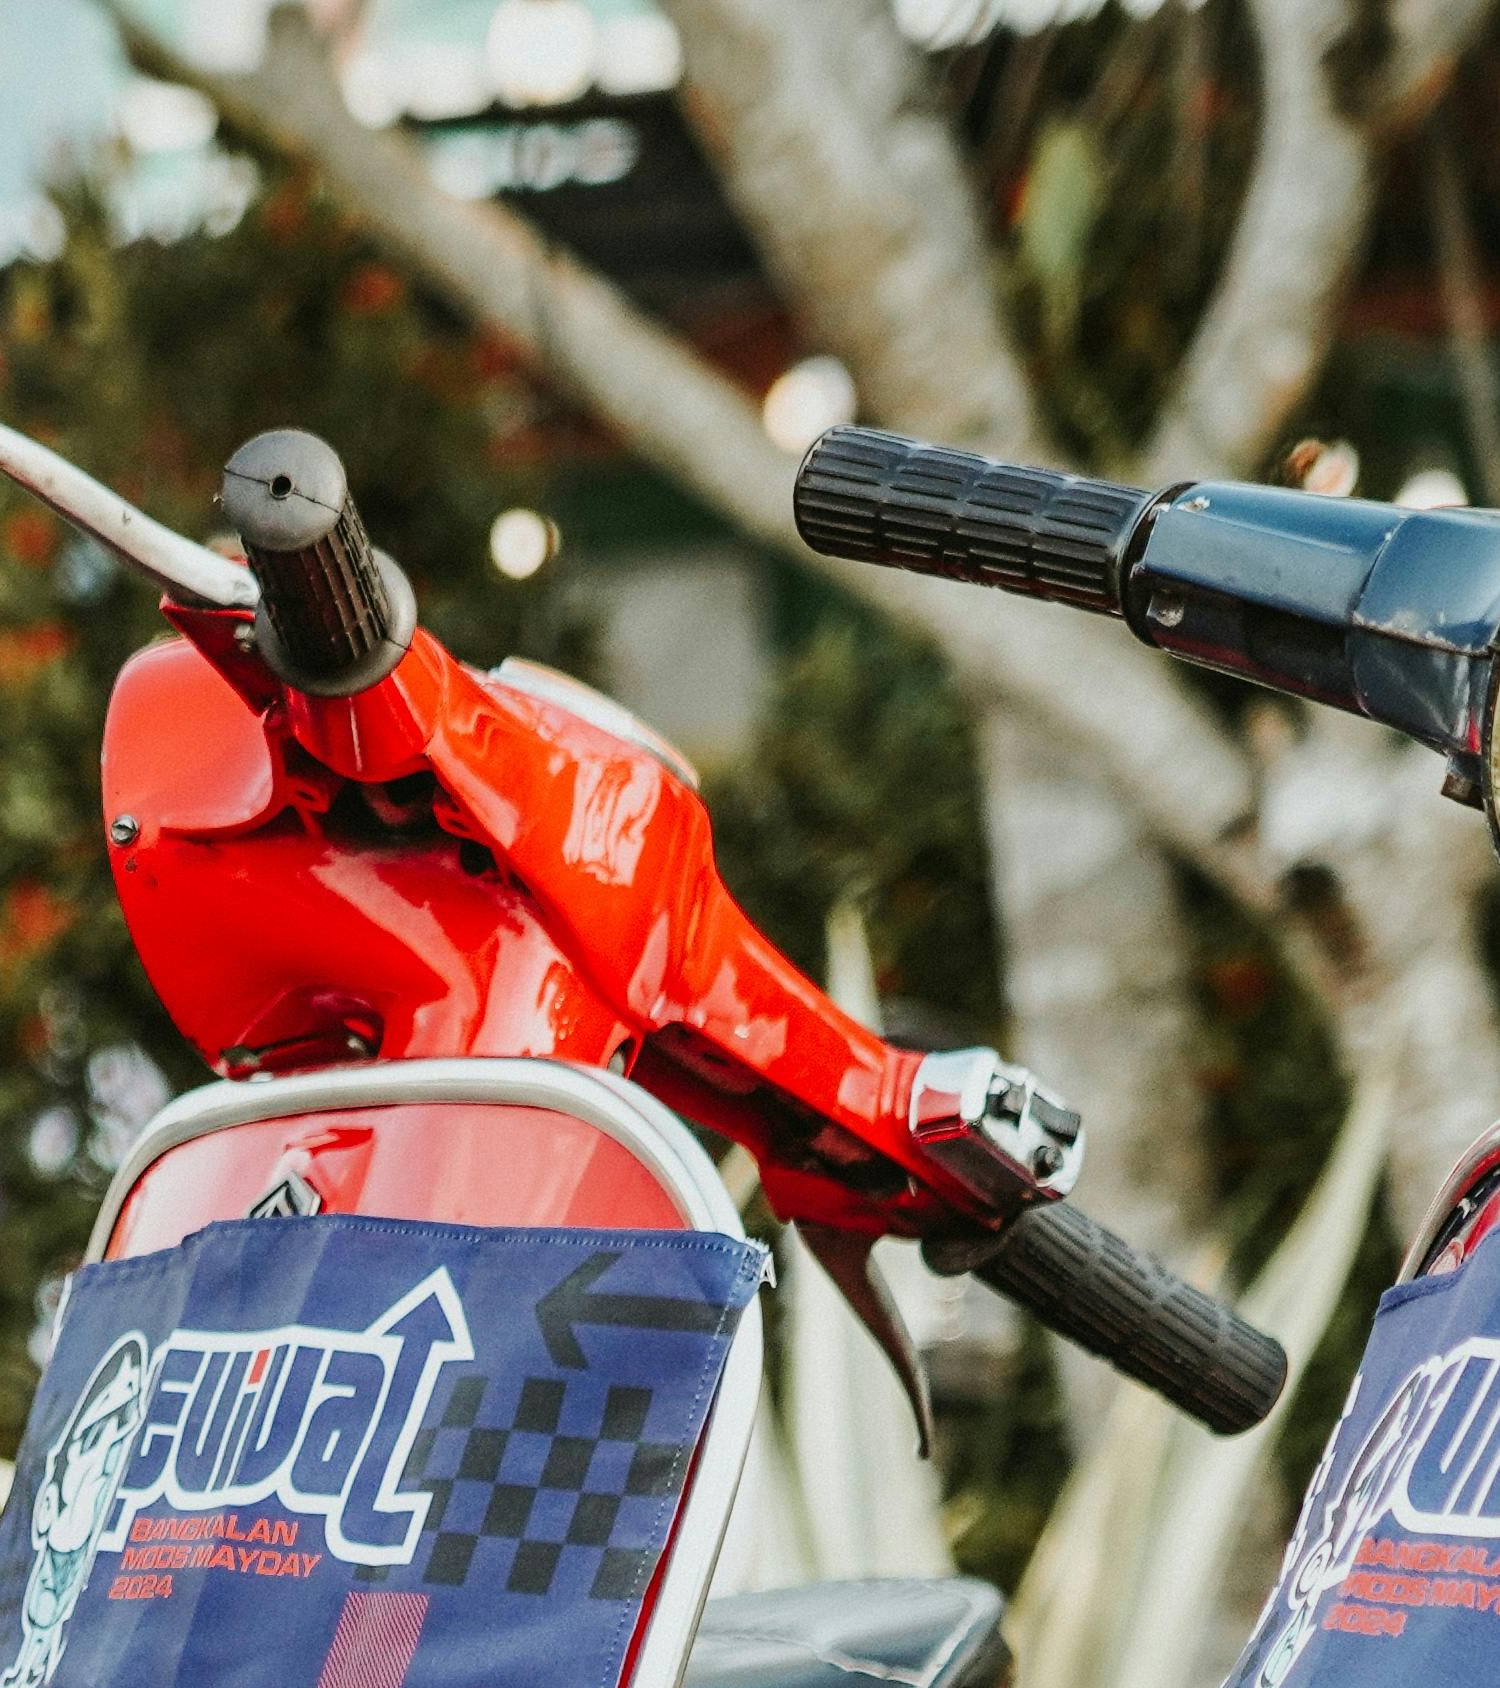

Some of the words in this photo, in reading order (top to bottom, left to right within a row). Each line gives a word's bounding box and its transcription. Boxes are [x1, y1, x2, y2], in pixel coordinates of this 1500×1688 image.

[100, 1267, 474, 1566] evival
[129, 1514, 299, 1547] BANGKALAN
[120, 1546, 190, 1571] MODS
[188, 1544, 322, 1578] MAYDAY
[108, 1574, 173, 1600] 2024
